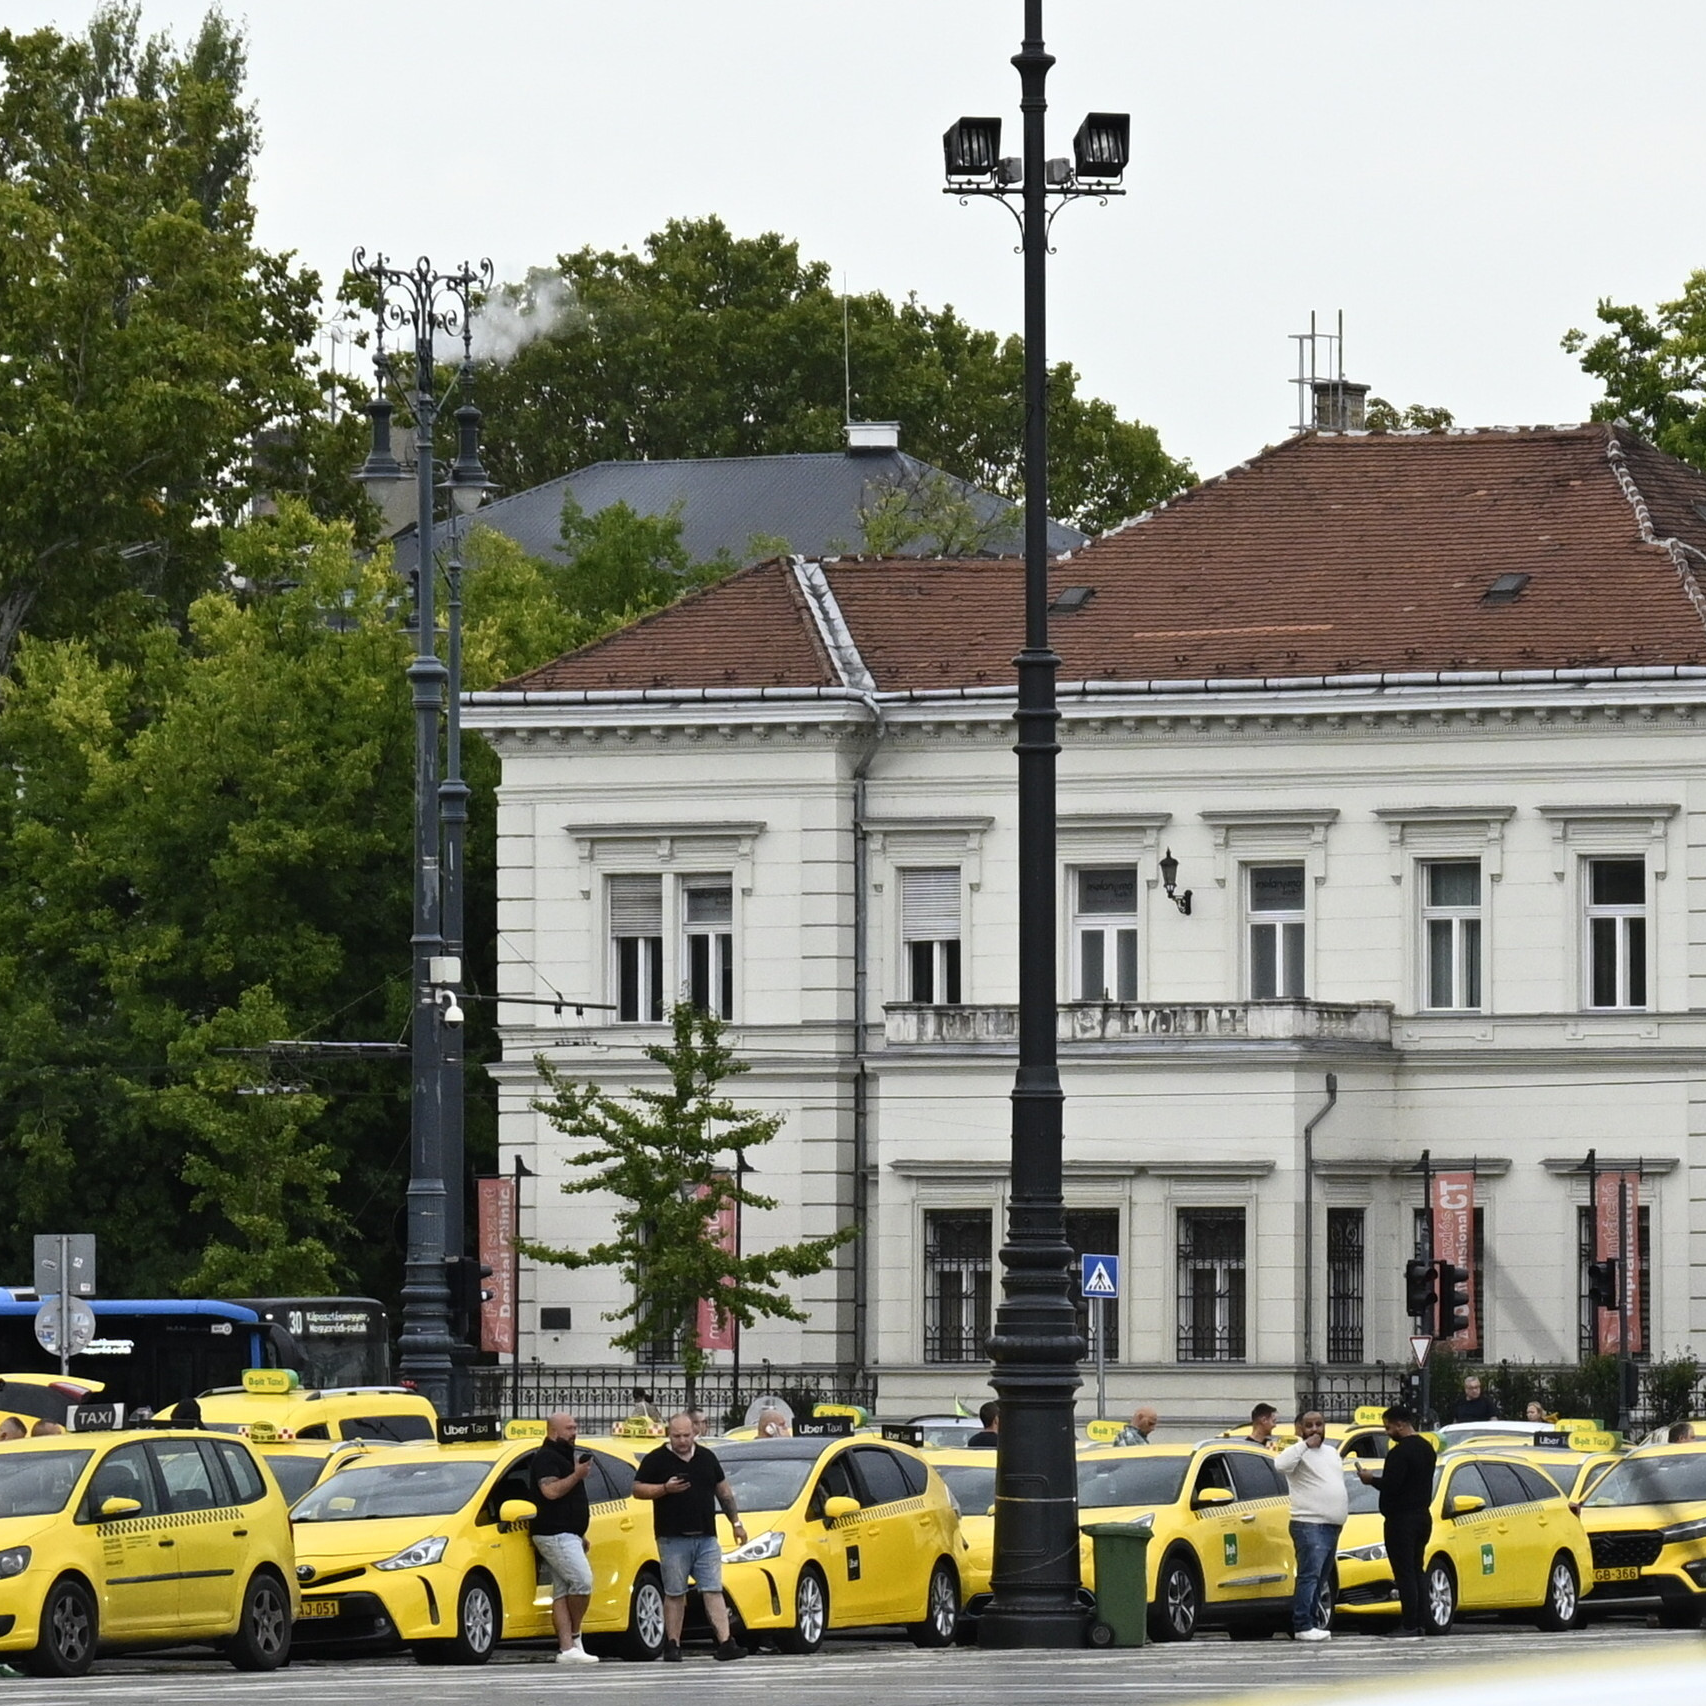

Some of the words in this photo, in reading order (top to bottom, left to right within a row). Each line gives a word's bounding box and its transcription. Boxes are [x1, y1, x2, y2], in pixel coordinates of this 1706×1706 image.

[1439, 1180, 1468, 1211] CT
[498, 1187, 511, 1245] Clinic
[499, 1252, 511, 1318] Dental
[289, 1311, 302, 1334] 30
[248, 1377, 265, 1387] Bolt
[267, 1377, 284, 1386] Taxi
[79, 1411, 113, 1425] TAXI
[443, 1424, 469, 1436] Uber
[471, 1422, 488, 1433] Taxi
[799, 1424, 824, 1434] Uber
[826, 1422, 843, 1433] Taxi
[1092, 1426, 1108, 1437] Bolt
[884, 1431, 900, 1440] Uber
[1539, 1437, 1560, 1446] Uber
[1574, 1436, 1591, 1447] Bolt
[1593, 1437, 1610, 1446] Taxi
